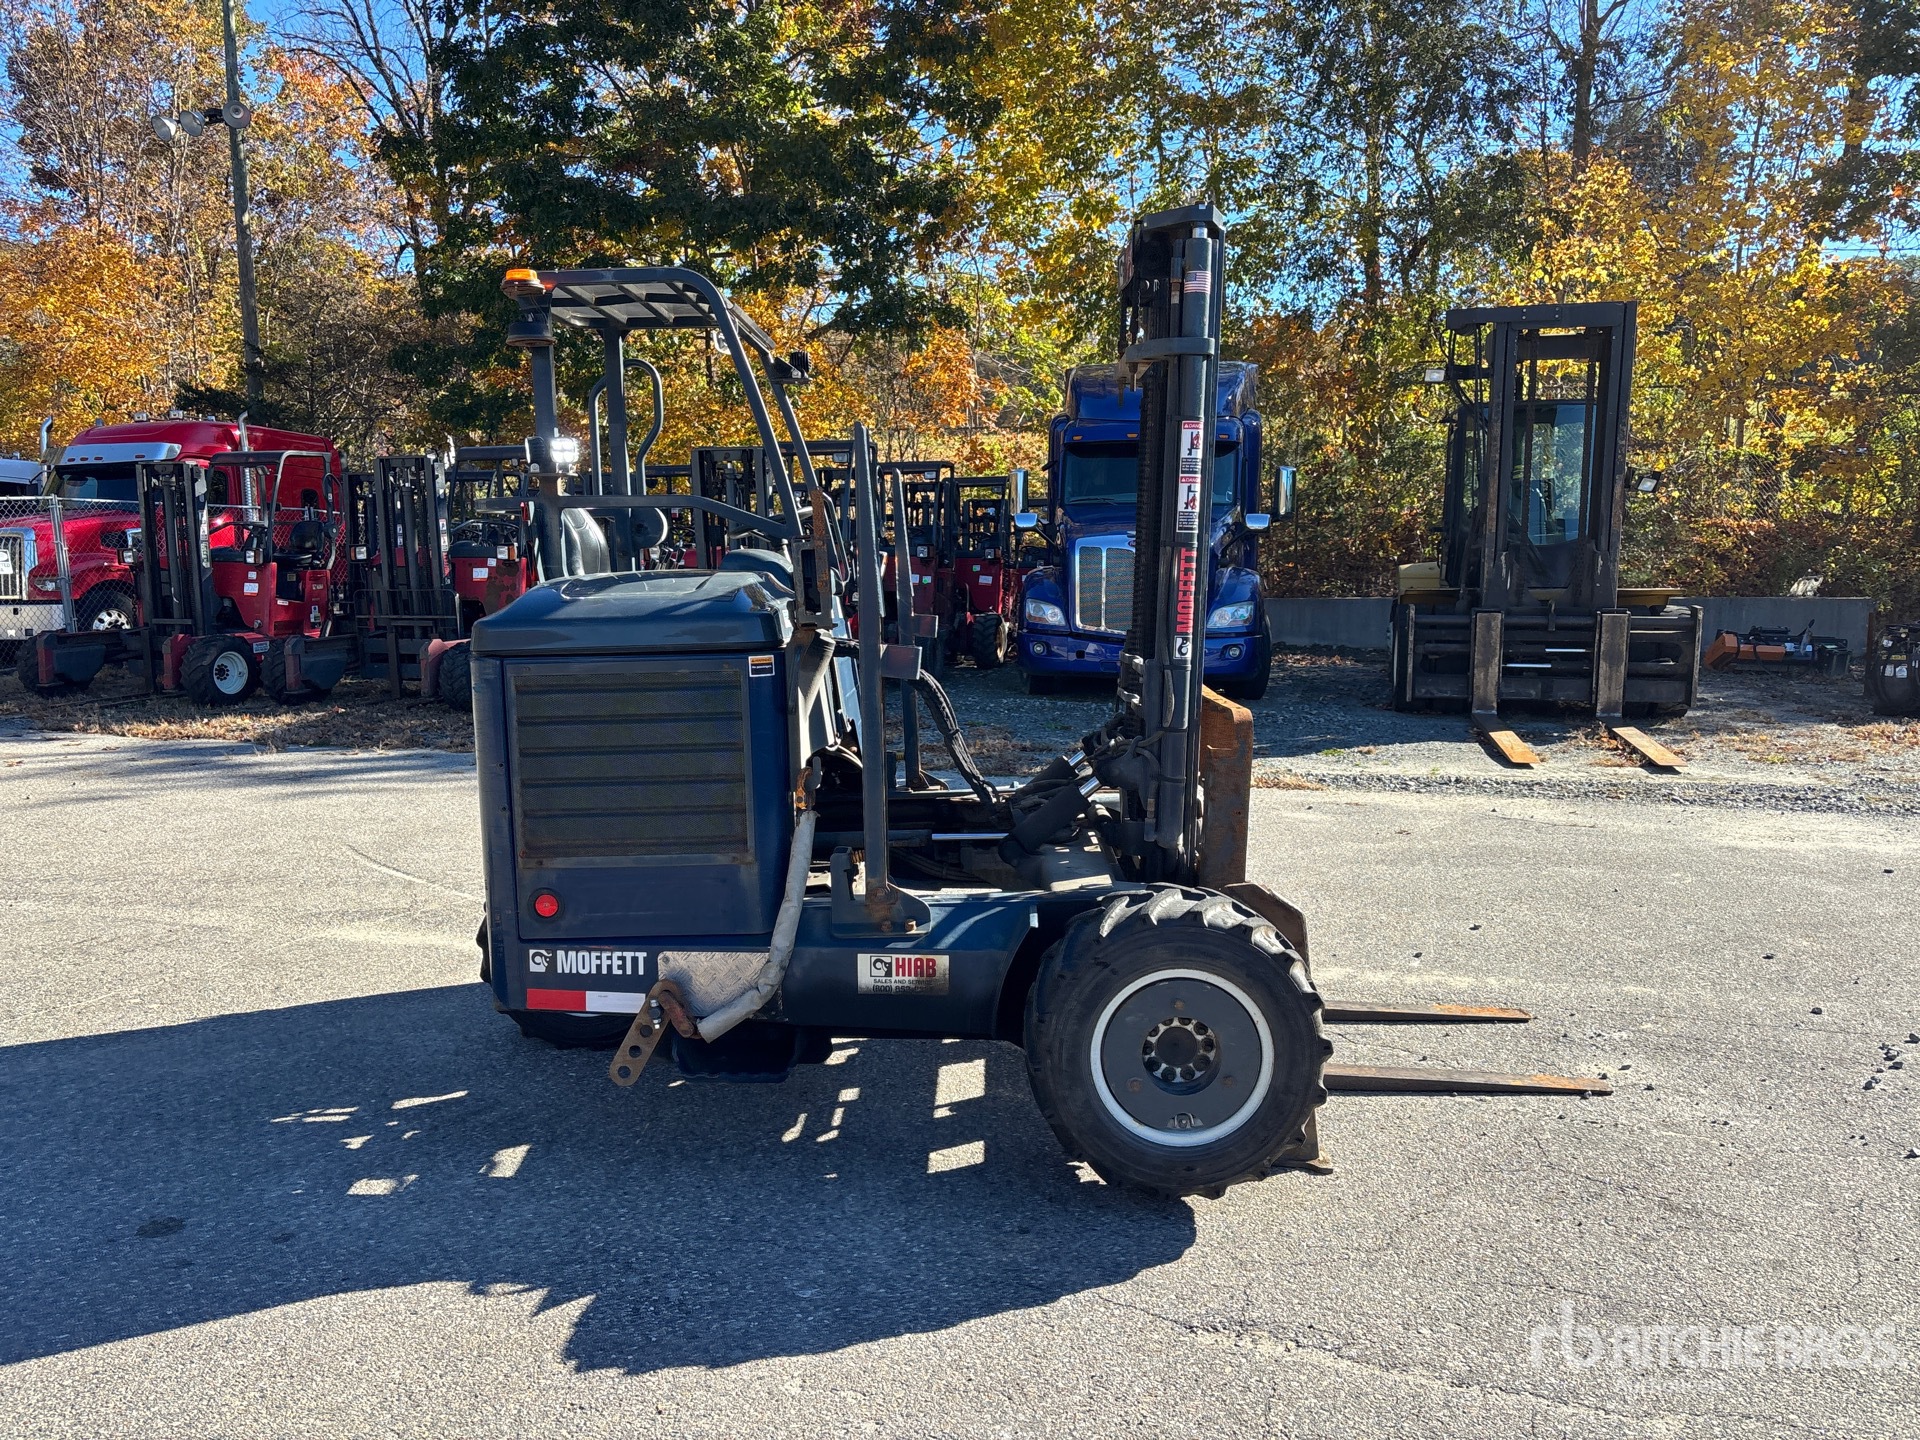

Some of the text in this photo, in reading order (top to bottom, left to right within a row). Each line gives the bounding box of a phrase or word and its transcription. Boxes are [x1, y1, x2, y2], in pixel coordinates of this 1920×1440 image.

[1176, 547, 1197, 633] MOFFETT
[556, 950, 647, 975] MOFFETT
[895, 957, 937, 977] HIAB
